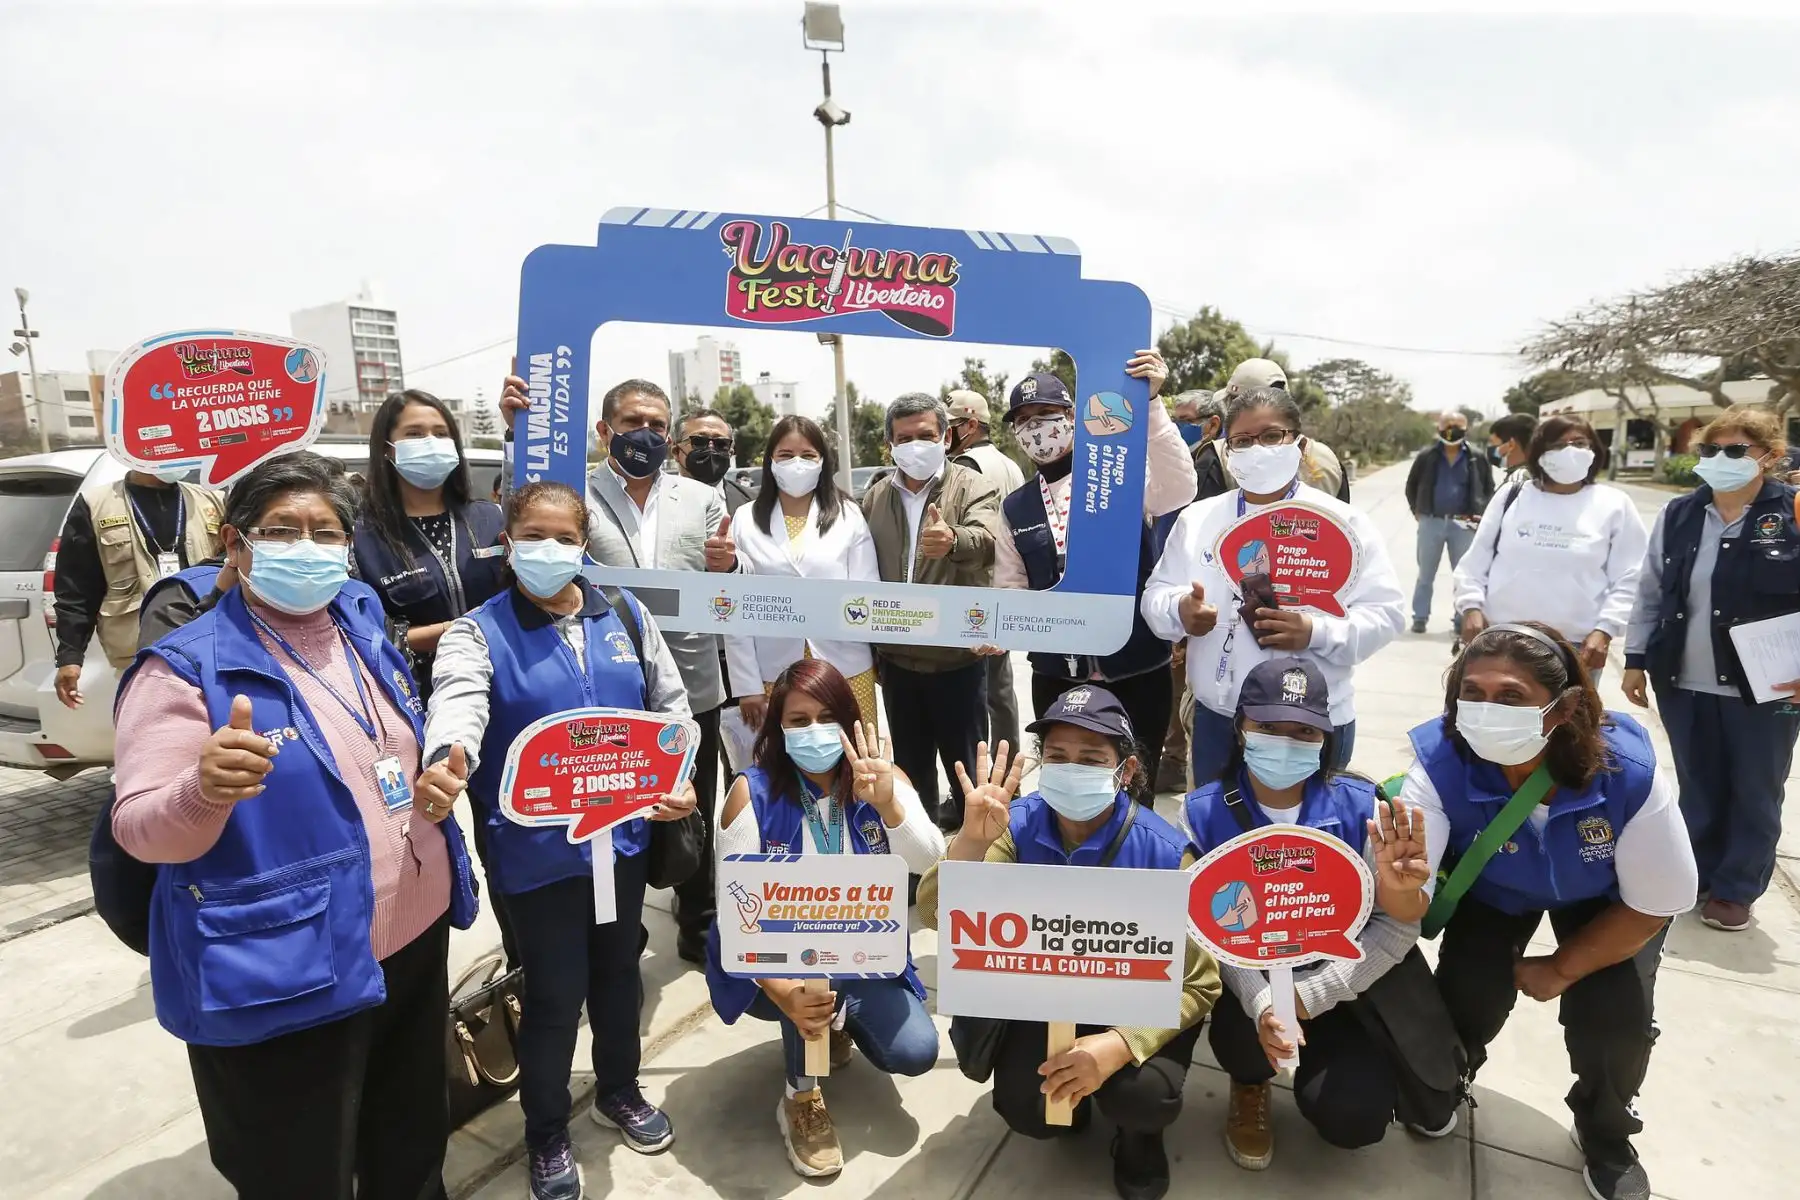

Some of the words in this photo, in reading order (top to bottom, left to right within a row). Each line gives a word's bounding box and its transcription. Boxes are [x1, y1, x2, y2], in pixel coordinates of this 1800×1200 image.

[722, 221, 958, 285] Vacuna
[738, 278, 822, 312] Fest
[842, 280, 945, 310] Liberteño
[174, 343, 252, 366] Vacuna
[185, 364, 213, 377] Fest
[177, 382, 244, 397] RECUERDA
[248, 379, 272, 391] QUE
[527, 352, 553, 441] VACUNA
[172, 400, 188, 410] LA
[191, 393, 244, 408] VACUNA
[248, 389, 281, 400] TIENE
[554, 374, 571, 423] VIDA
[196, 411, 212, 432] 2
[213, 404, 270, 431] DOSIS
[553, 430, 569, 456] ES
[1103, 444, 1114, 458] el
[526, 443, 550, 471] LA
[1086, 442, 1098, 467] por
[1112, 445, 1127, 485] Pongo
[1087, 468, 1099, 482] el
[1099, 458, 1113, 509] hombro
[1085, 483, 1097, 513] Perú
[1277, 545, 1307, 557] Pongo
[1277, 556, 1287, 564] el
[1287, 557, 1327, 567] hombro
[1275, 566, 1293, 577] por
[1294, 567, 1304, 576] el
[1305, 568, 1329, 578] Perú
[742, 594, 792, 604] GOBIERNO
[872, 600, 889, 608] RED
[890, 601, 901, 609] DE
[742, 603, 796, 614] REGIONAL
[742, 612, 754, 620] LA
[757, 613, 806, 623] LIBERTAD
[872, 608, 934, 618] UNIVERSIDADES
[871, 617, 922, 626] SALUDABLES
[1002, 615, 1044, 623] GERENCIA
[1045, 617, 1087, 626] REGIONAL
[1002, 623, 1015, 631] DE
[1018, 624, 1052, 633] SALUD
[1282, 692, 1305, 704] MPT
[1062, 704, 1085, 713] MPT
[567, 720, 630, 738] Vacuna
[573, 736, 595, 747] Fest
[561, 753, 618, 765] RECUERDA
[622, 750, 644, 761] QUE
[554, 765, 569, 776] LA
[571, 761, 618, 773] VACUNA
[620, 758, 651, 769] TIENE
[573, 776, 585, 795] 2
[586, 771, 637, 793] DOSIS
[1249, 844, 1315, 861] Vacuna
[1255, 860, 1279, 874] Fest
[762, 881, 841, 902] Vamos
[846, 886, 861, 902] a
[866, 883, 894, 902] tu
[1264, 882, 1304, 895] Pongo
[1265, 895, 1278, 907] el
[1279, 892, 1330, 906] hombro
[767, 901, 890, 920] encuentro
[1265, 910, 1289, 925] por
[1290, 907, 1303, 920] el
[1305, 904, 1336, 917] Perú
[793, 921, 843, 932] ¡Vacúnate
[844, 922, 861, 933] ya!
[950, 909, 1029, 949] NO
[1031, 914, 1139, 937] bajemos
[1041, 934, 1064, 951] la
[1072, 936, 1174, 957] guardia
[984, 954, 1026, 970] ANTE
[1032, 956, 1052, 972] LA
[1058, 959, 1131, 976] COVID-19
